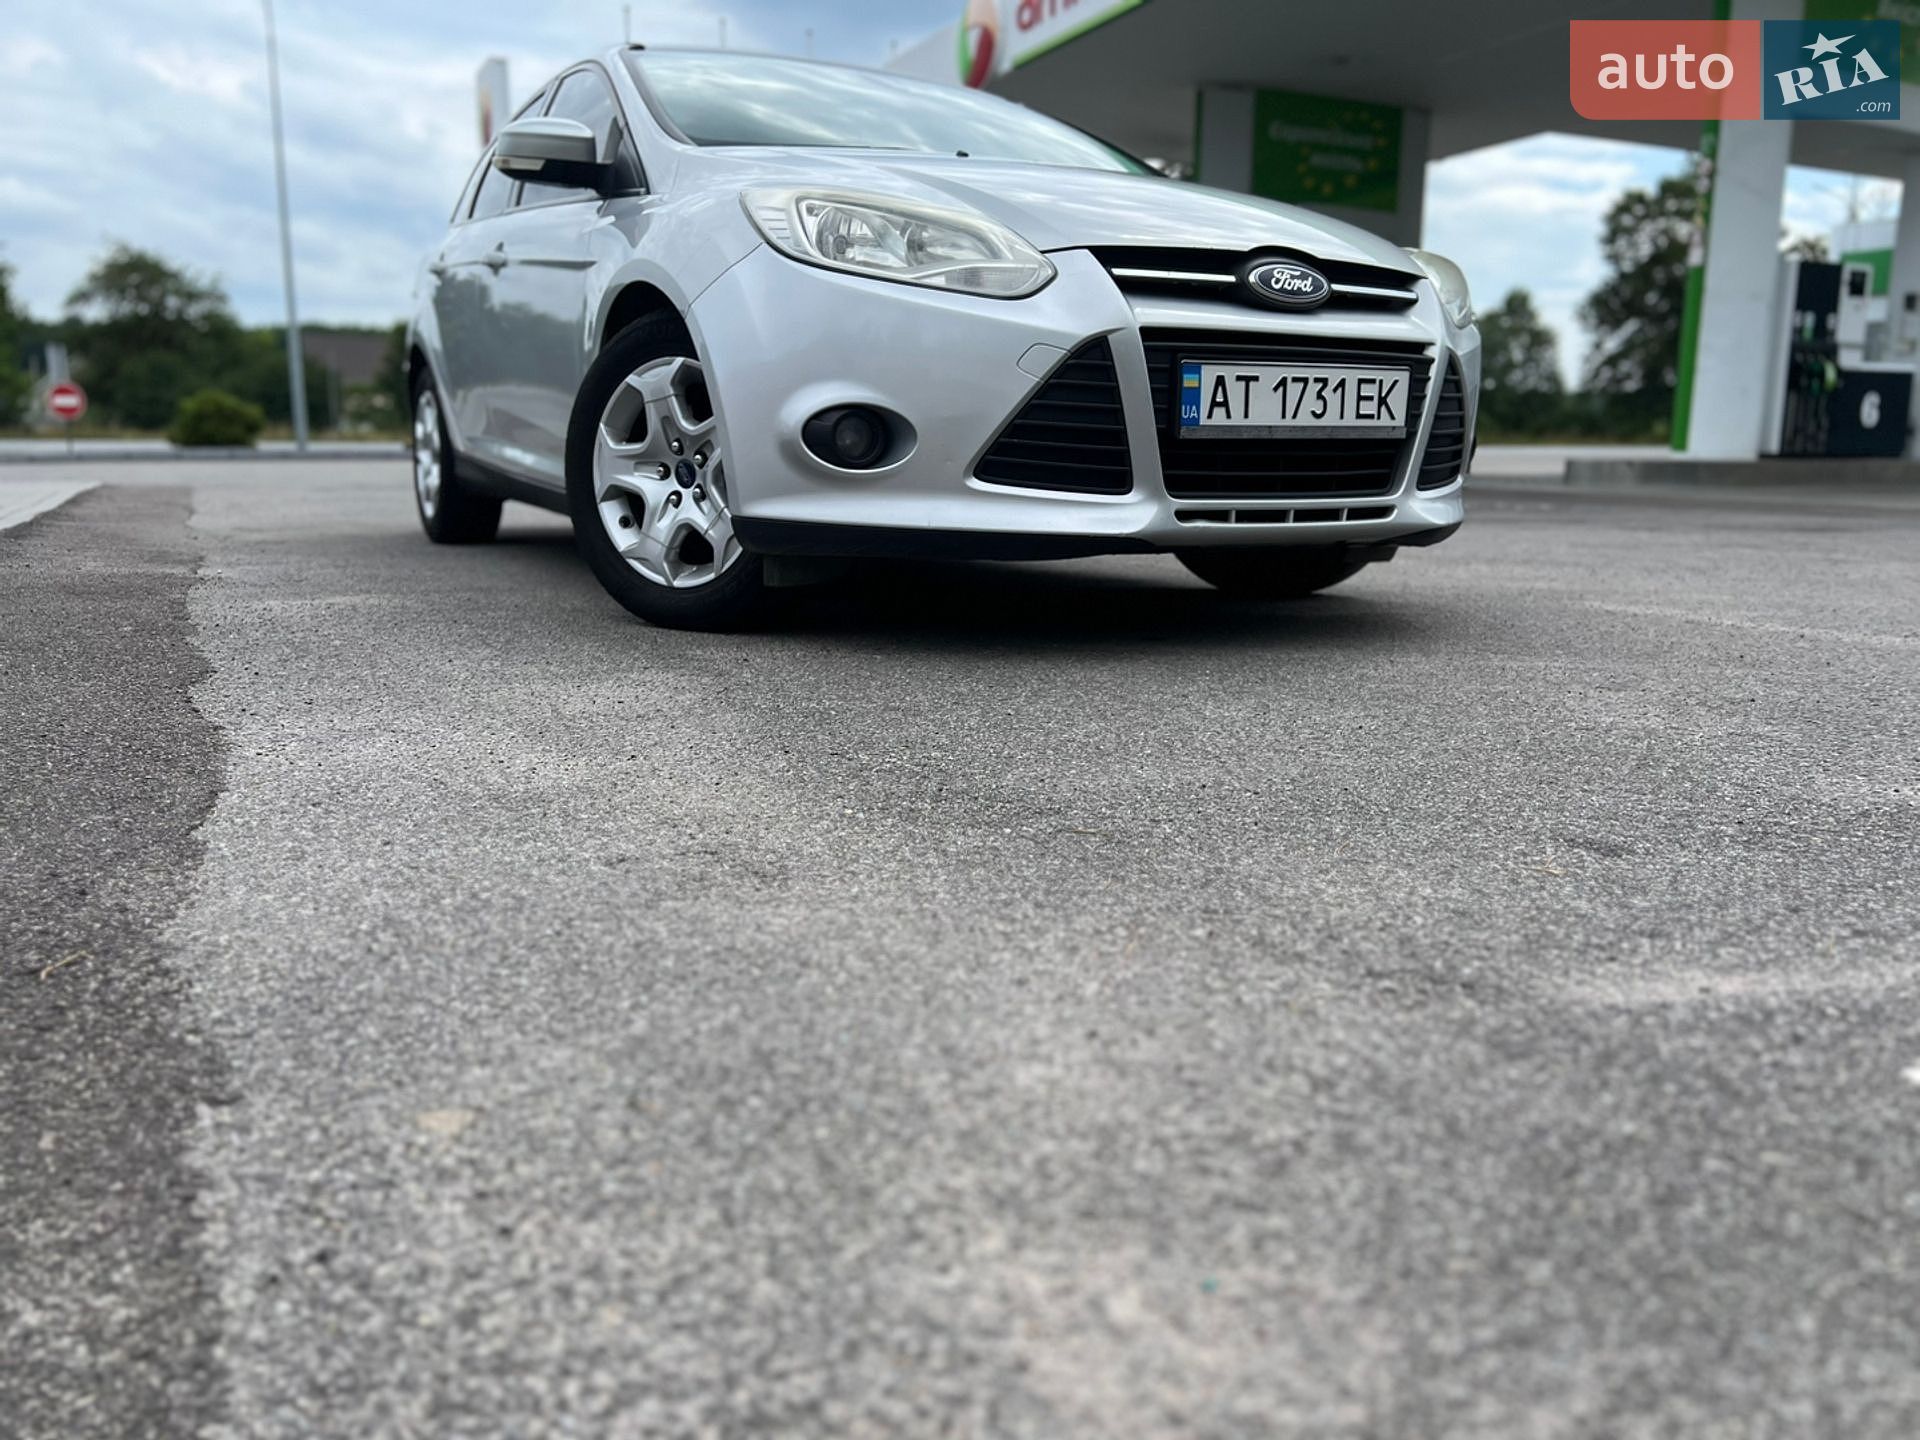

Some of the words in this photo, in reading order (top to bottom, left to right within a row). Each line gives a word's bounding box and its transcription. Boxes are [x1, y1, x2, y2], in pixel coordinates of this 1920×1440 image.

[1271, 268, 1313, 292] Ford
[1181, 405, 1198, 419] UA
[1206, 375, 1260, 420] AT
[1272, 376, 1347, 420] 1731
[1355, 378, 1400, 421] EK
[1859, 390, 1881, 429] 6
